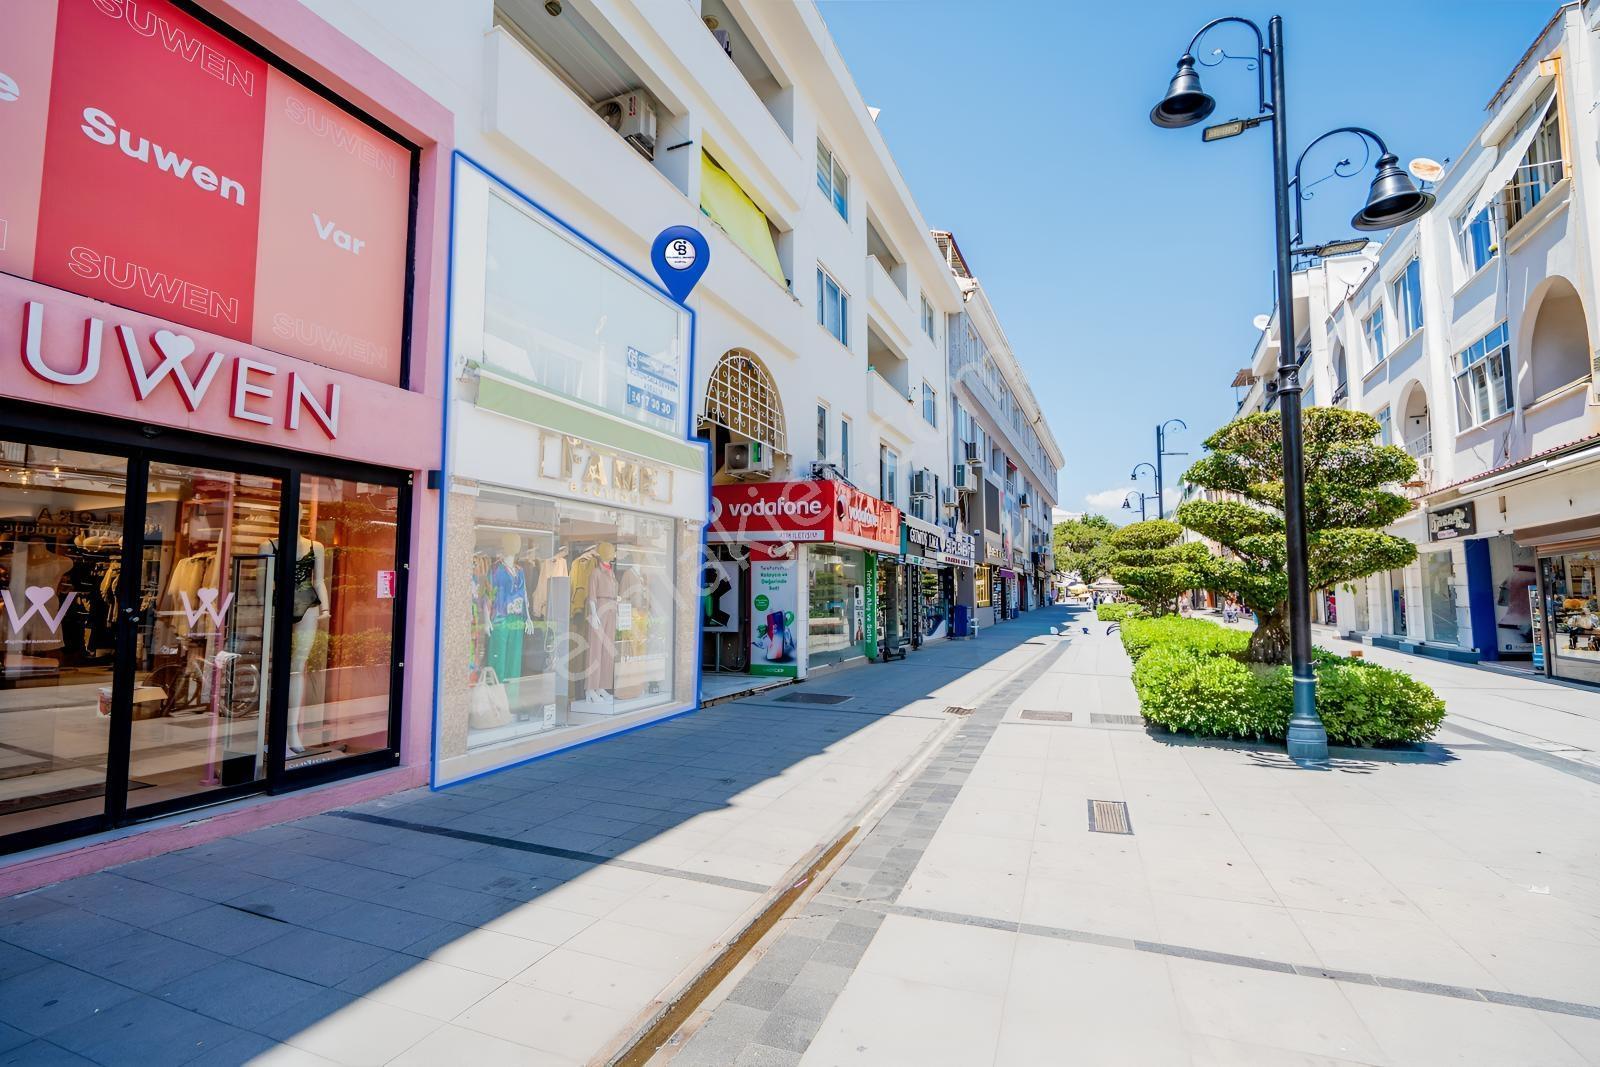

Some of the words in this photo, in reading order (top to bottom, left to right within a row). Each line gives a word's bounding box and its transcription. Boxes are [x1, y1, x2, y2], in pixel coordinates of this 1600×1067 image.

[80, 106, 246, 206] Suwen
[284, 96, 397, 179] SUWEN
[312, 212, 366, 255] Var
[67, 245, 239, 325] SUWEN
[272, 312, 389, 369] SUWEN
[729, 496, 822, 516] vodafone
